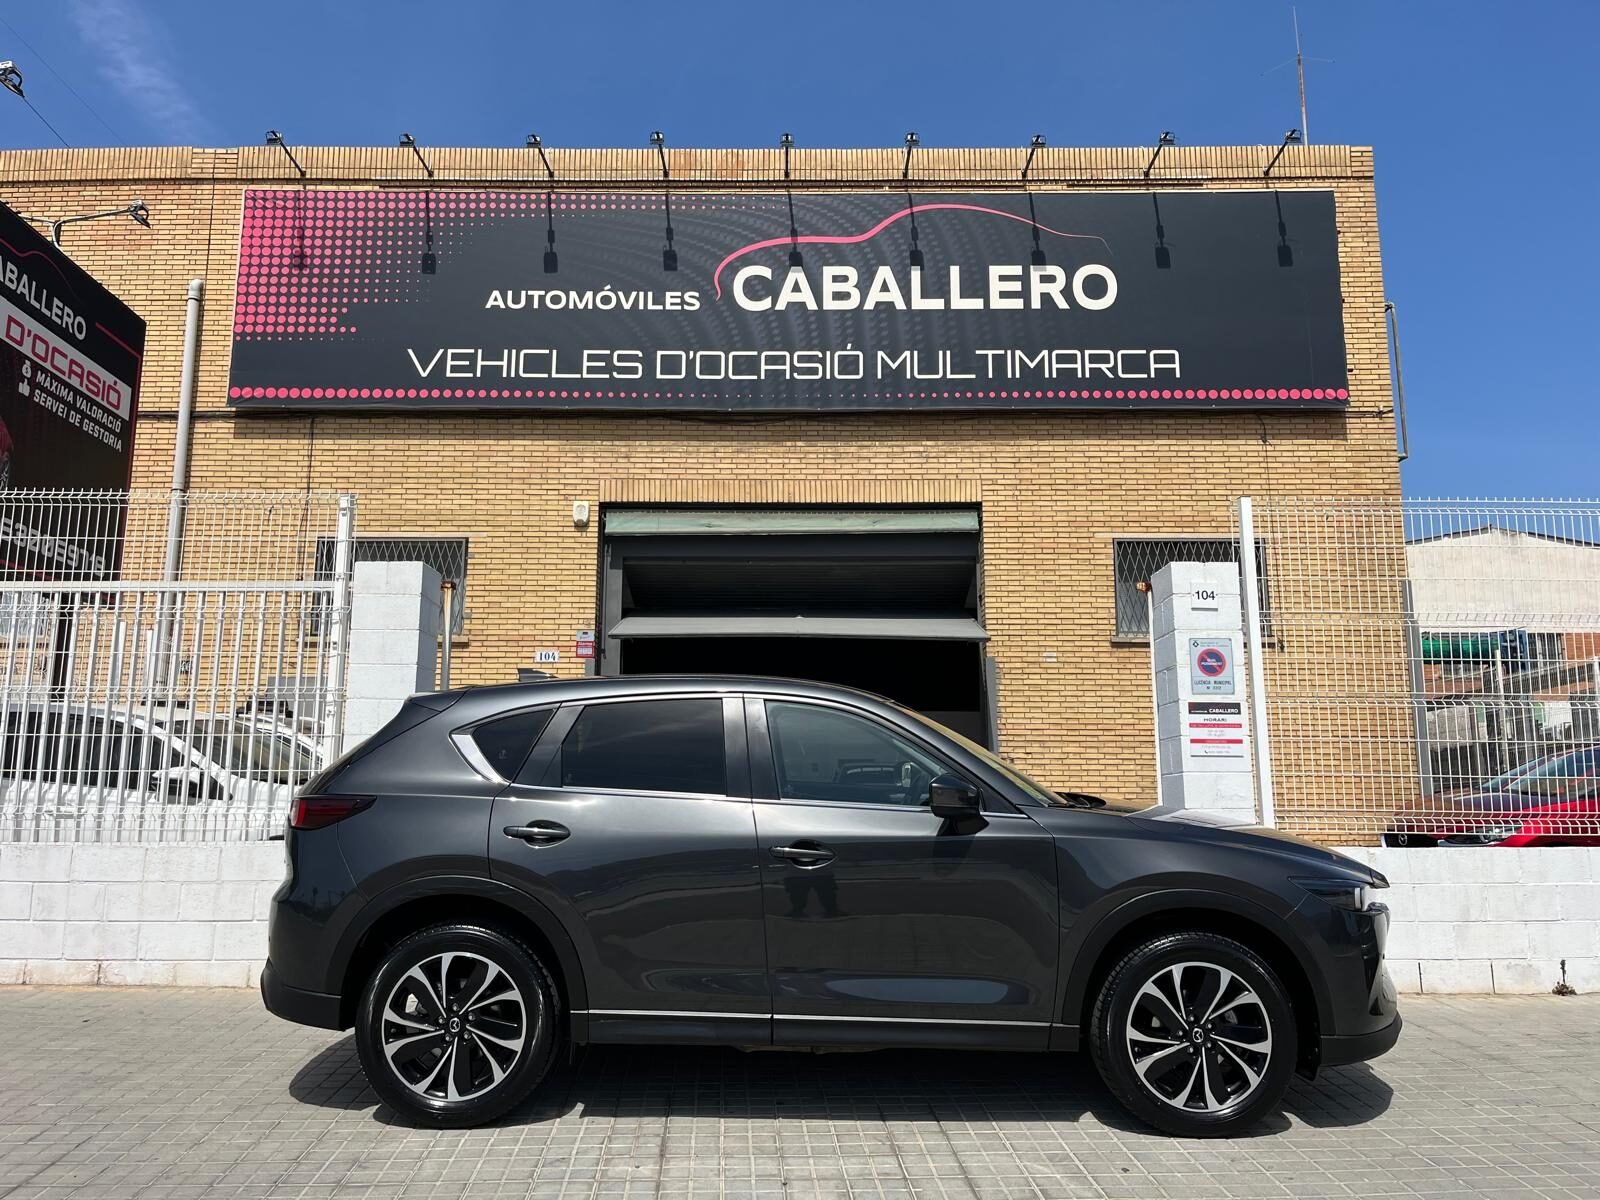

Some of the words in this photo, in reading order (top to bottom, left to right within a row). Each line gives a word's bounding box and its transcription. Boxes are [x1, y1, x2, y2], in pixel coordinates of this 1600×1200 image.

[485, 284, 701, 311] AUTOMÓVILES
[732, 263, 1119, 313] CABALLERO
[5, 314, 122, 412] D'OCASIÓ
[406, 348, 644, 380] VEHICLES
[655, 343, 864, 380] D'OCASIÓ
[876, 349, 1181, 380] MULTIMARCA
[33, 389, 68, 419] SERVEI
[68, 409, 82, 428] DE
[82, 418, 122, 453] GESTORIA
[36, 370, 74, 405] MÀXIMA
[76, 394, 122, 433] VALORACIÓ
[1195, 590, 1216, 601] 104
[540, 652, 556, 661] 104
